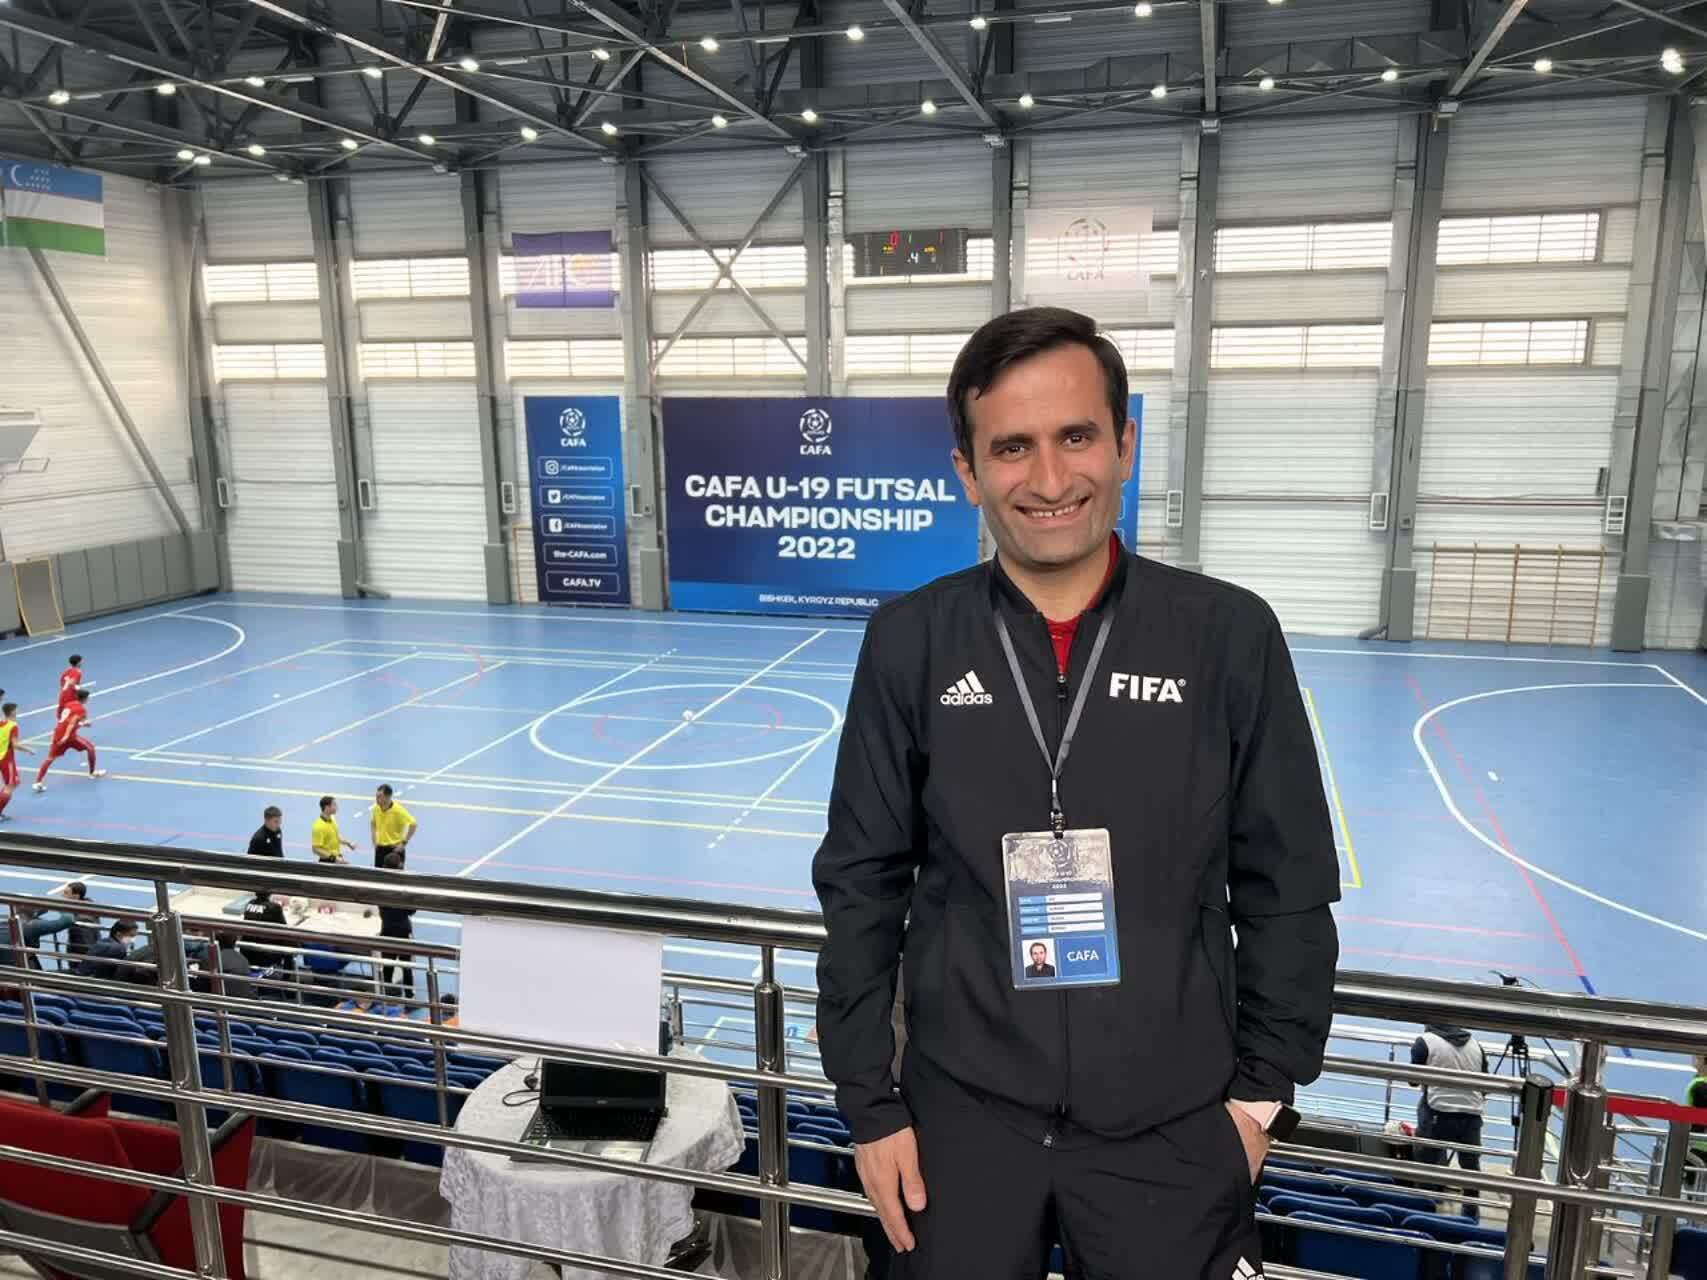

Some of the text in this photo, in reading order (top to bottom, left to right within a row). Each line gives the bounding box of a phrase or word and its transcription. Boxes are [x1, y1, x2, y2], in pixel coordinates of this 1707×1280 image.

[560, 438, 586, 447] CAFA
[800, 445, 832, 455] CAFA
[685, 475, 956, 502] CAFA U-19 FUTSAL
[705, 505, 934, 532] CHAMPIONSHIP
[778, 536, 856, 560] 2022
[562, 578, 601, 588] CAFA.TV
[1109, 672, 1183, 703] FIFA
[940, 692, 993, 705] adidas
[1066, 950, 1100, 962] CAFA
